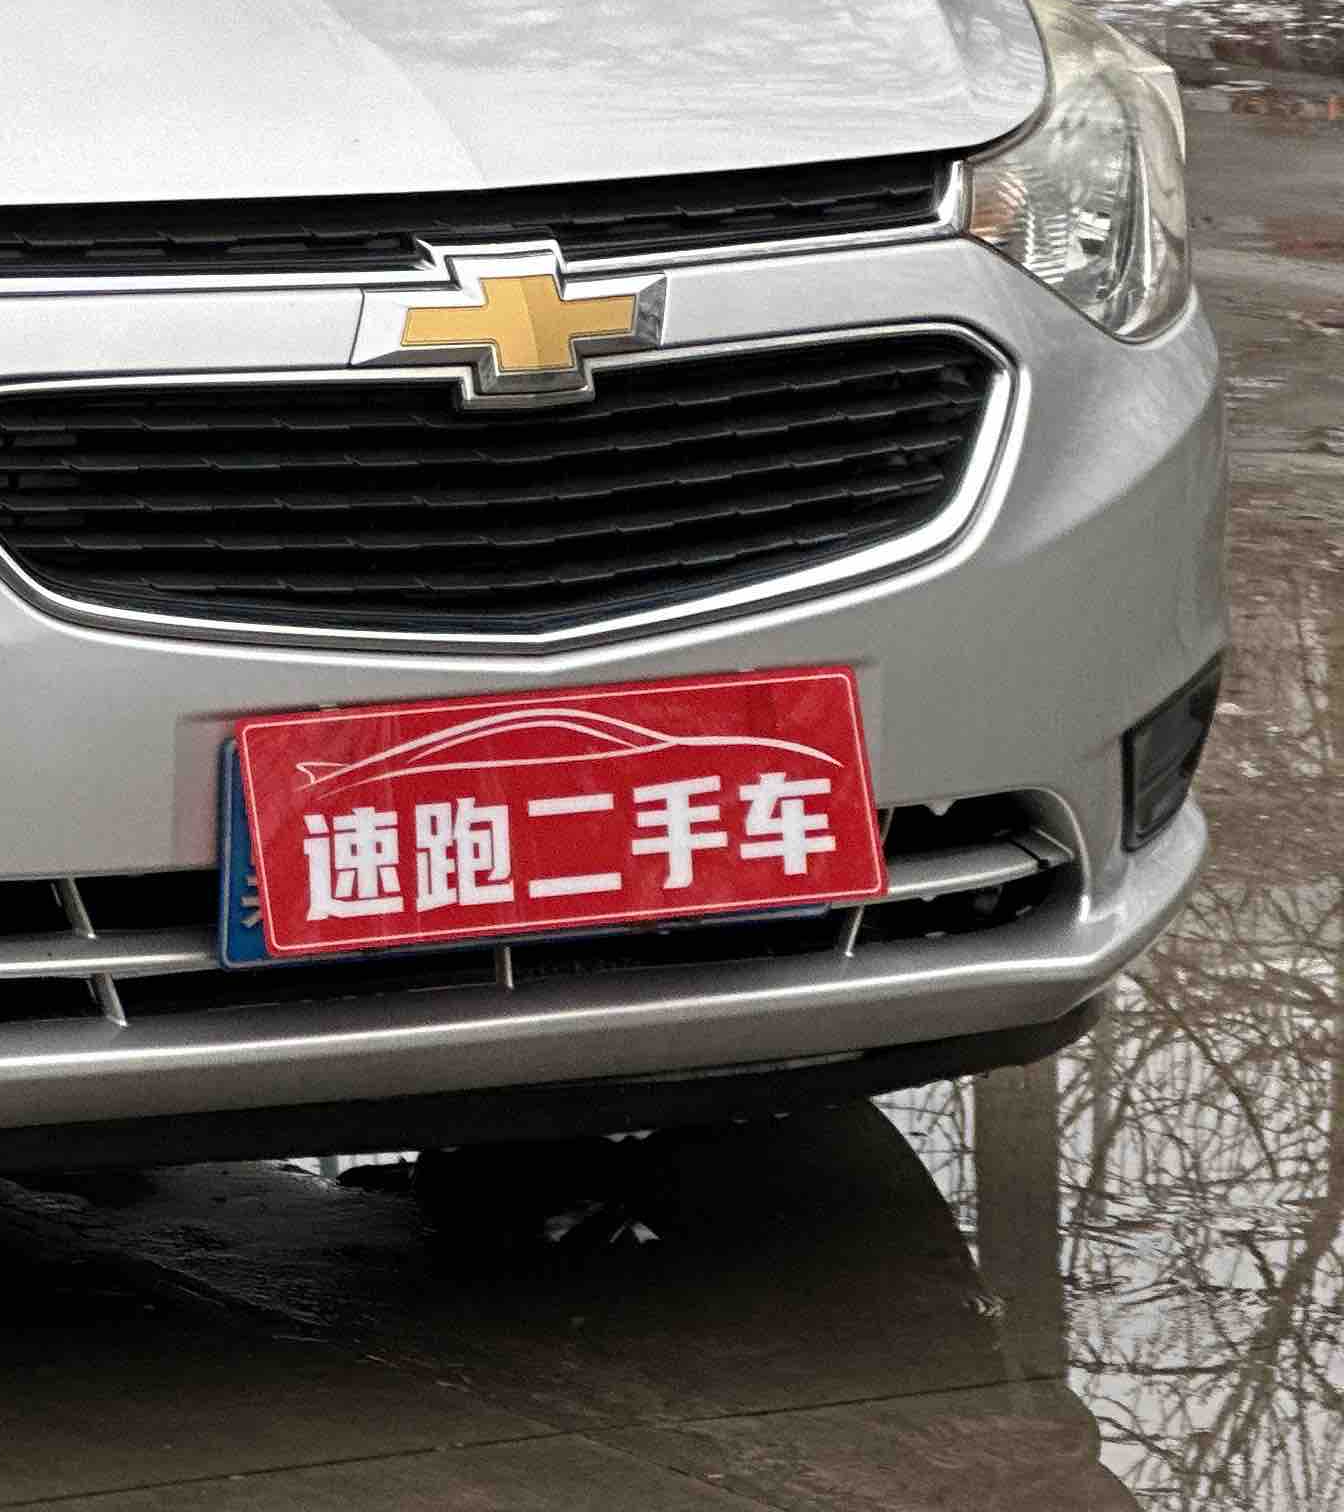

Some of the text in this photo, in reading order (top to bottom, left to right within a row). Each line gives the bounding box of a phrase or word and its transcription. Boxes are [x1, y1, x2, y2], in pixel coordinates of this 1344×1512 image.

[302, 772, 836, 921] 速跑二手车
